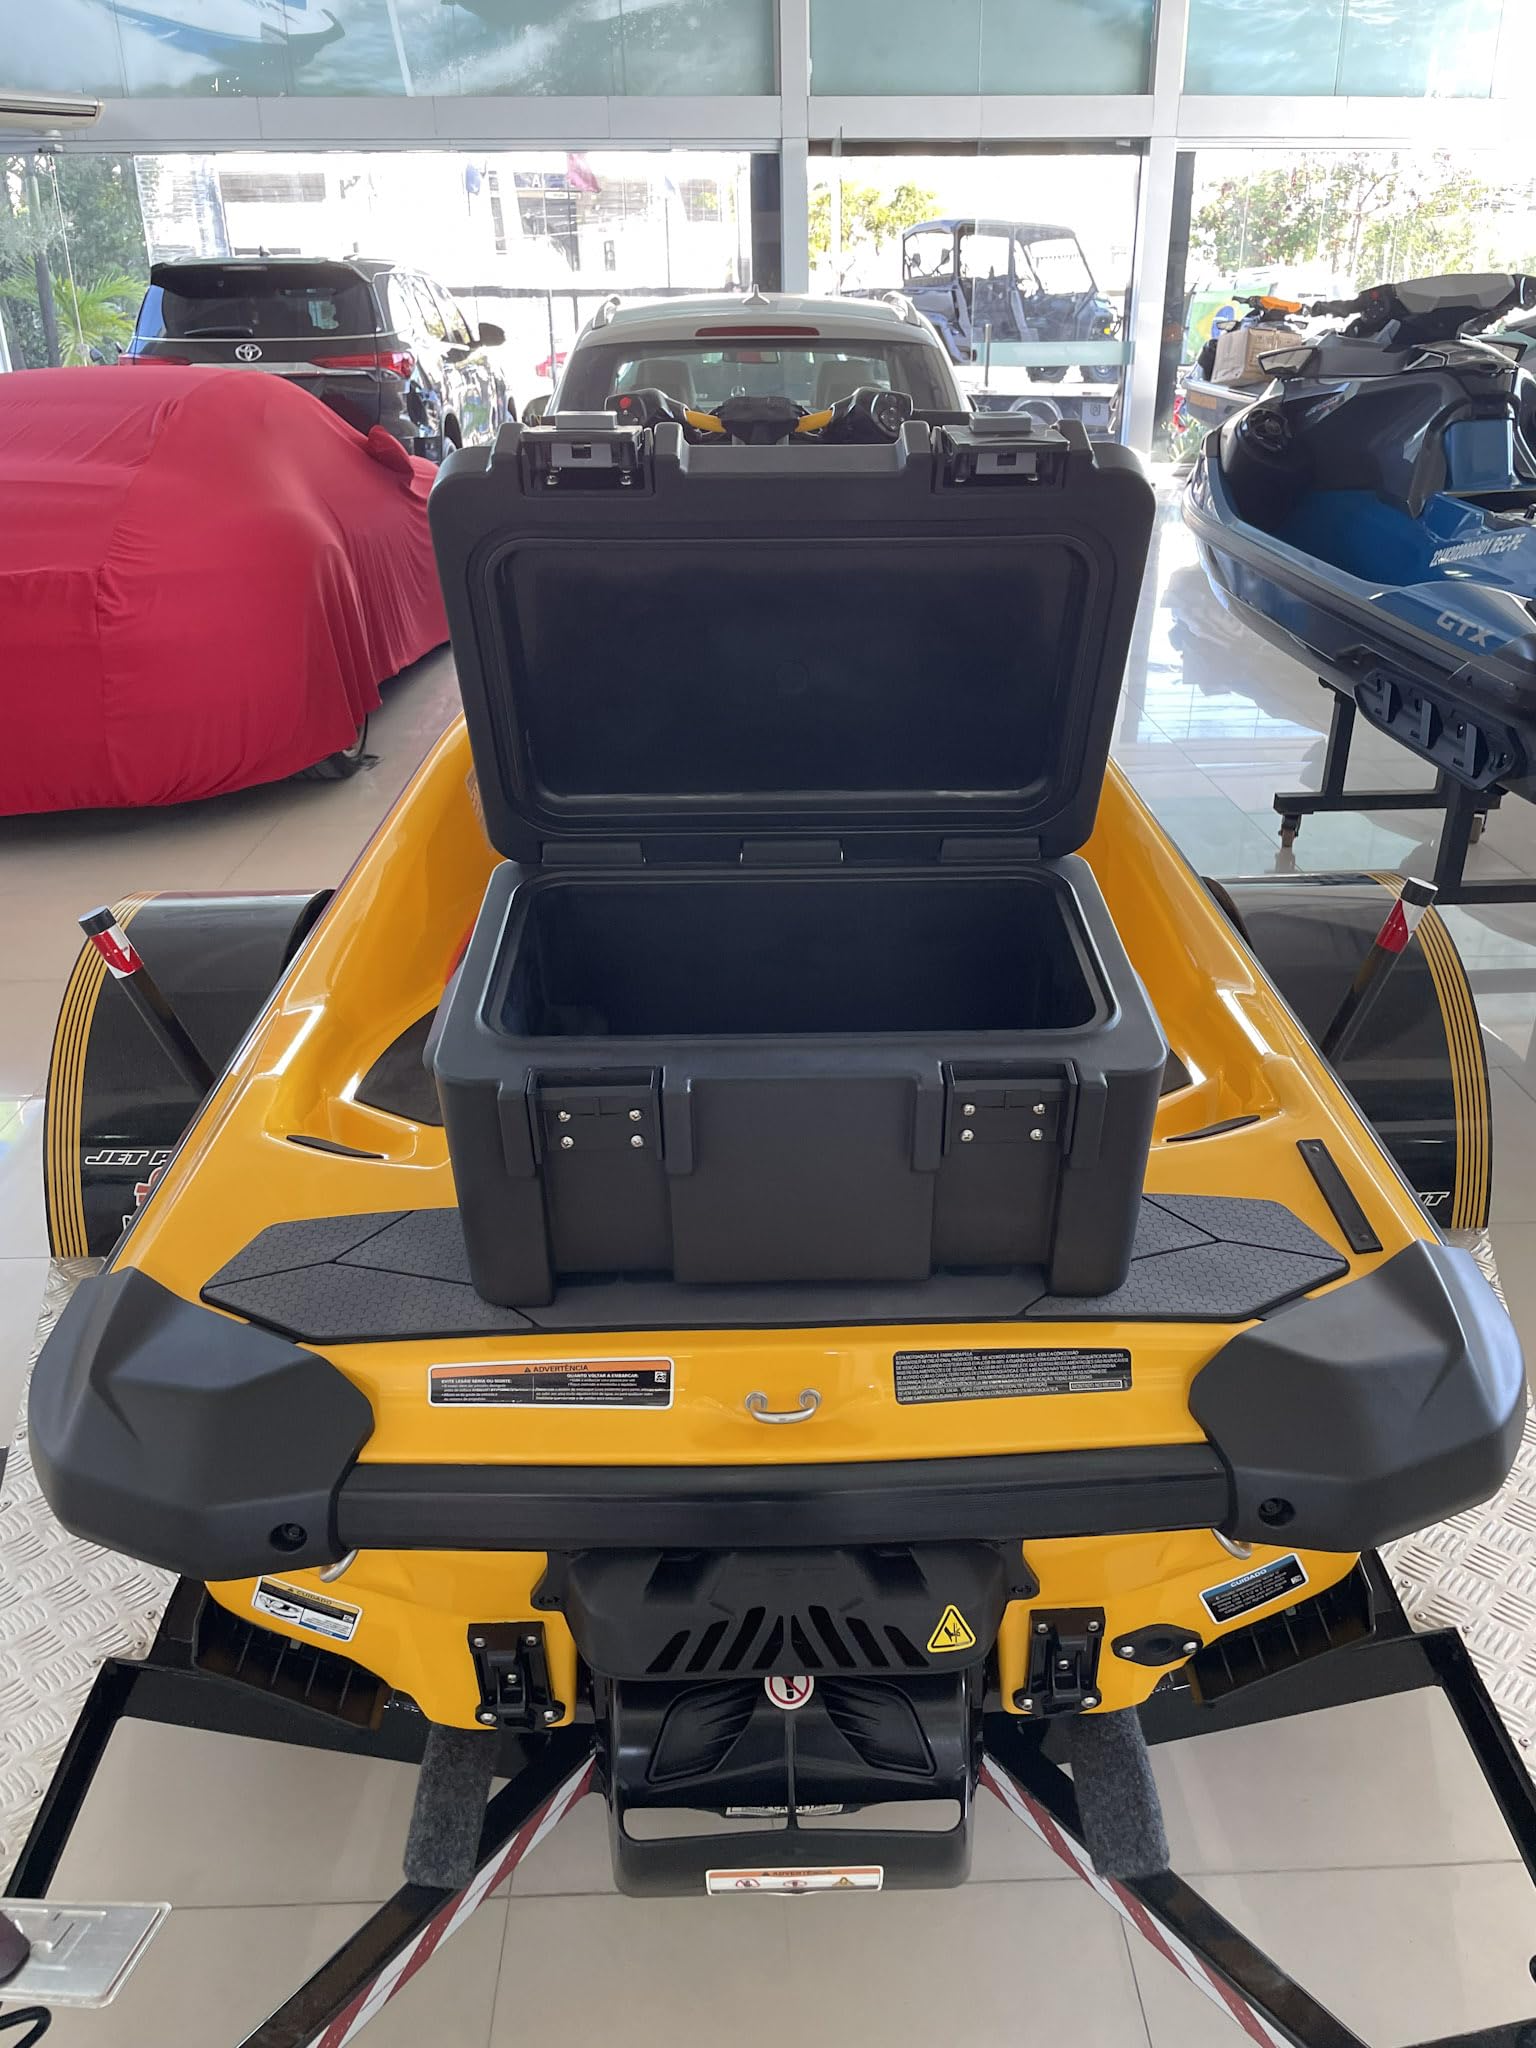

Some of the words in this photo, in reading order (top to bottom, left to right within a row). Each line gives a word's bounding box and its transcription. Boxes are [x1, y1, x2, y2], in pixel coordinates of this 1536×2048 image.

[1436, 610, 1495, 648] GTX
[85, 1150, 149, 1165] JET
[533, 1364, 589, 1373] ADVERTÊNCIA
[1230, 1568, 1267, 1588] CUIDADO
